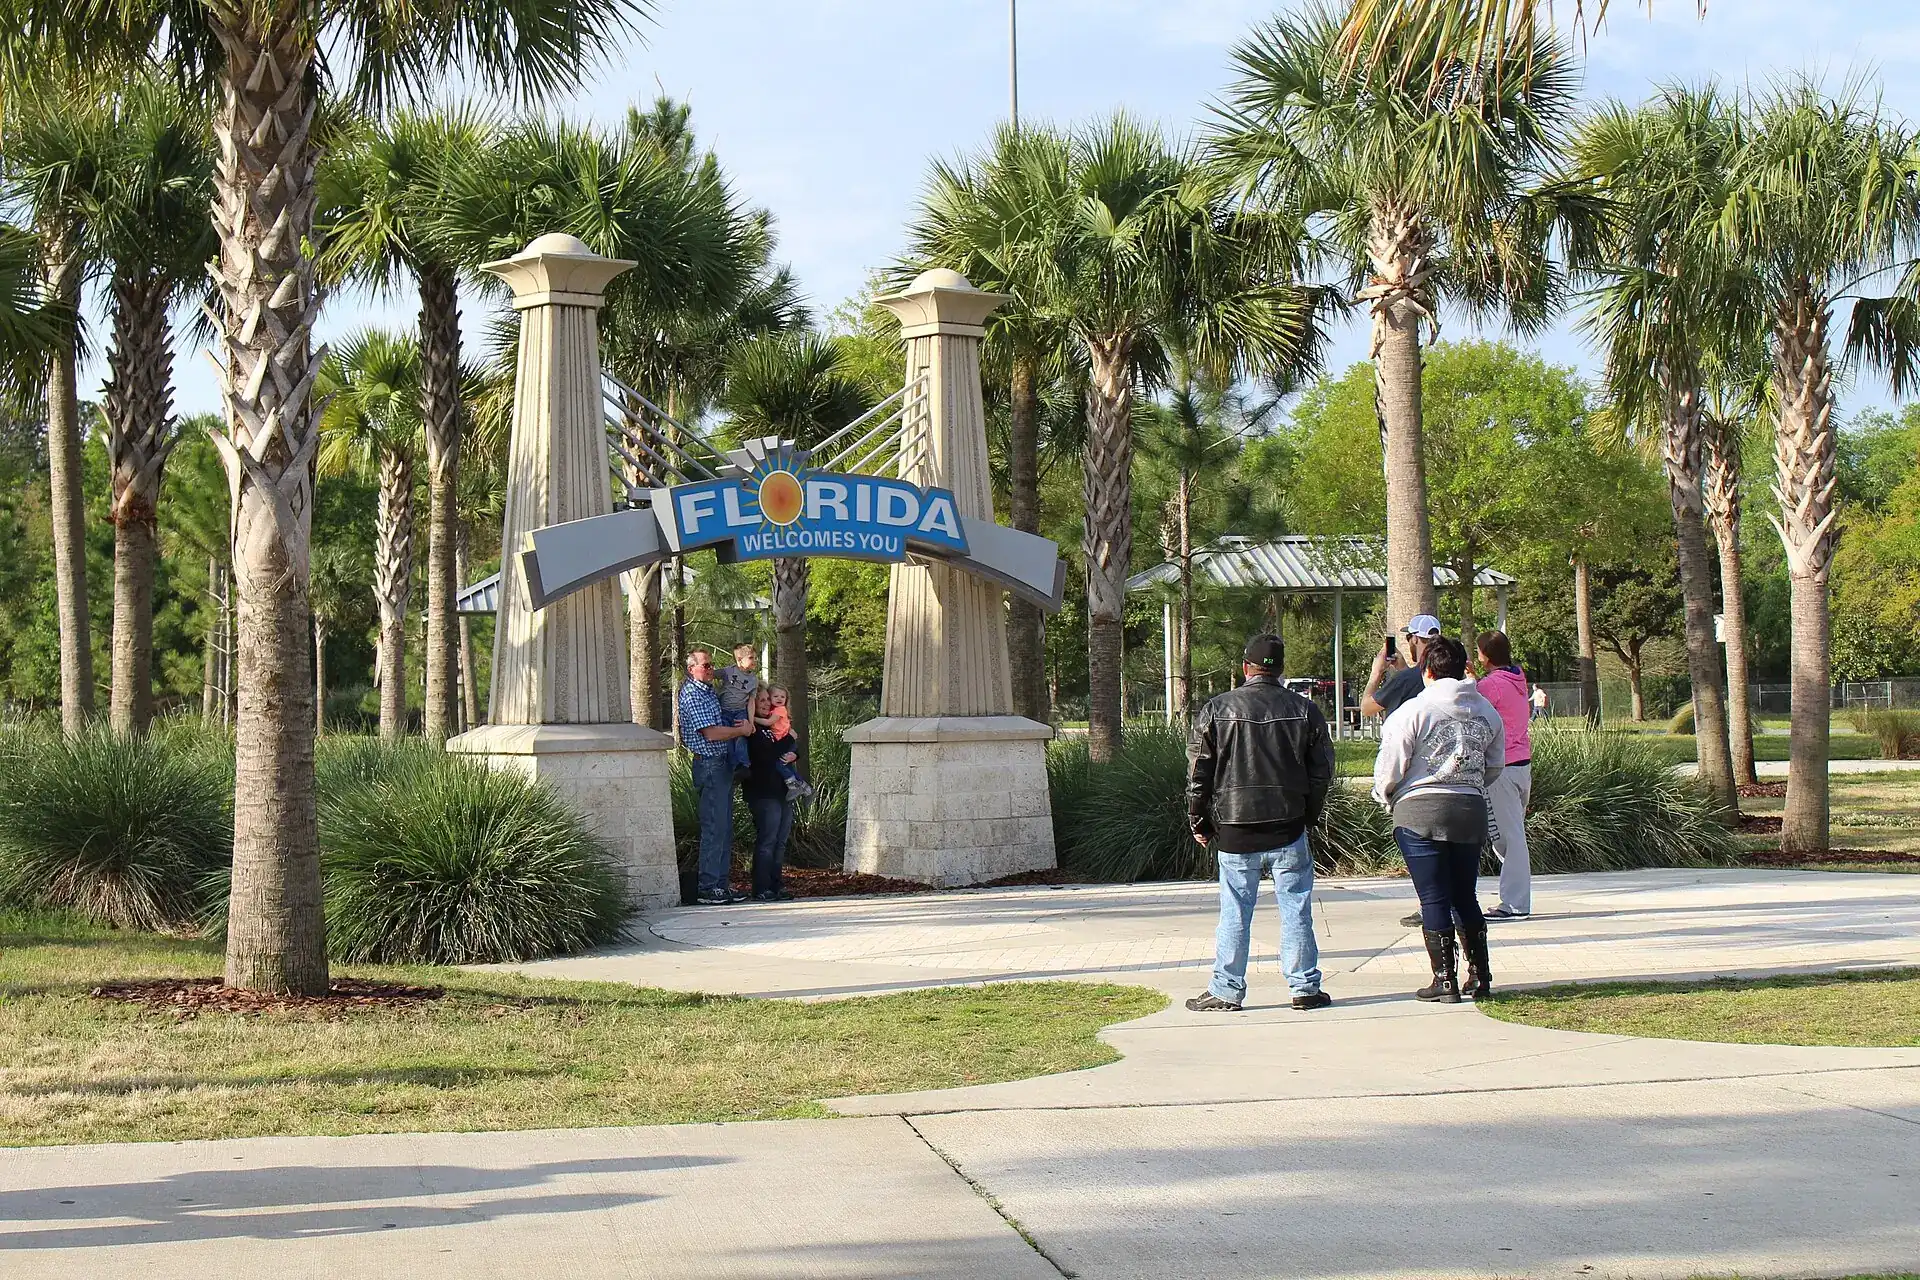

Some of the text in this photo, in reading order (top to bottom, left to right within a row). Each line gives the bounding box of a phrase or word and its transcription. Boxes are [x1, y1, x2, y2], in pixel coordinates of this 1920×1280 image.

[678, 470, 961, 540] FLORIDA
[743, 529, 899, 554] WELCOMES YOU
